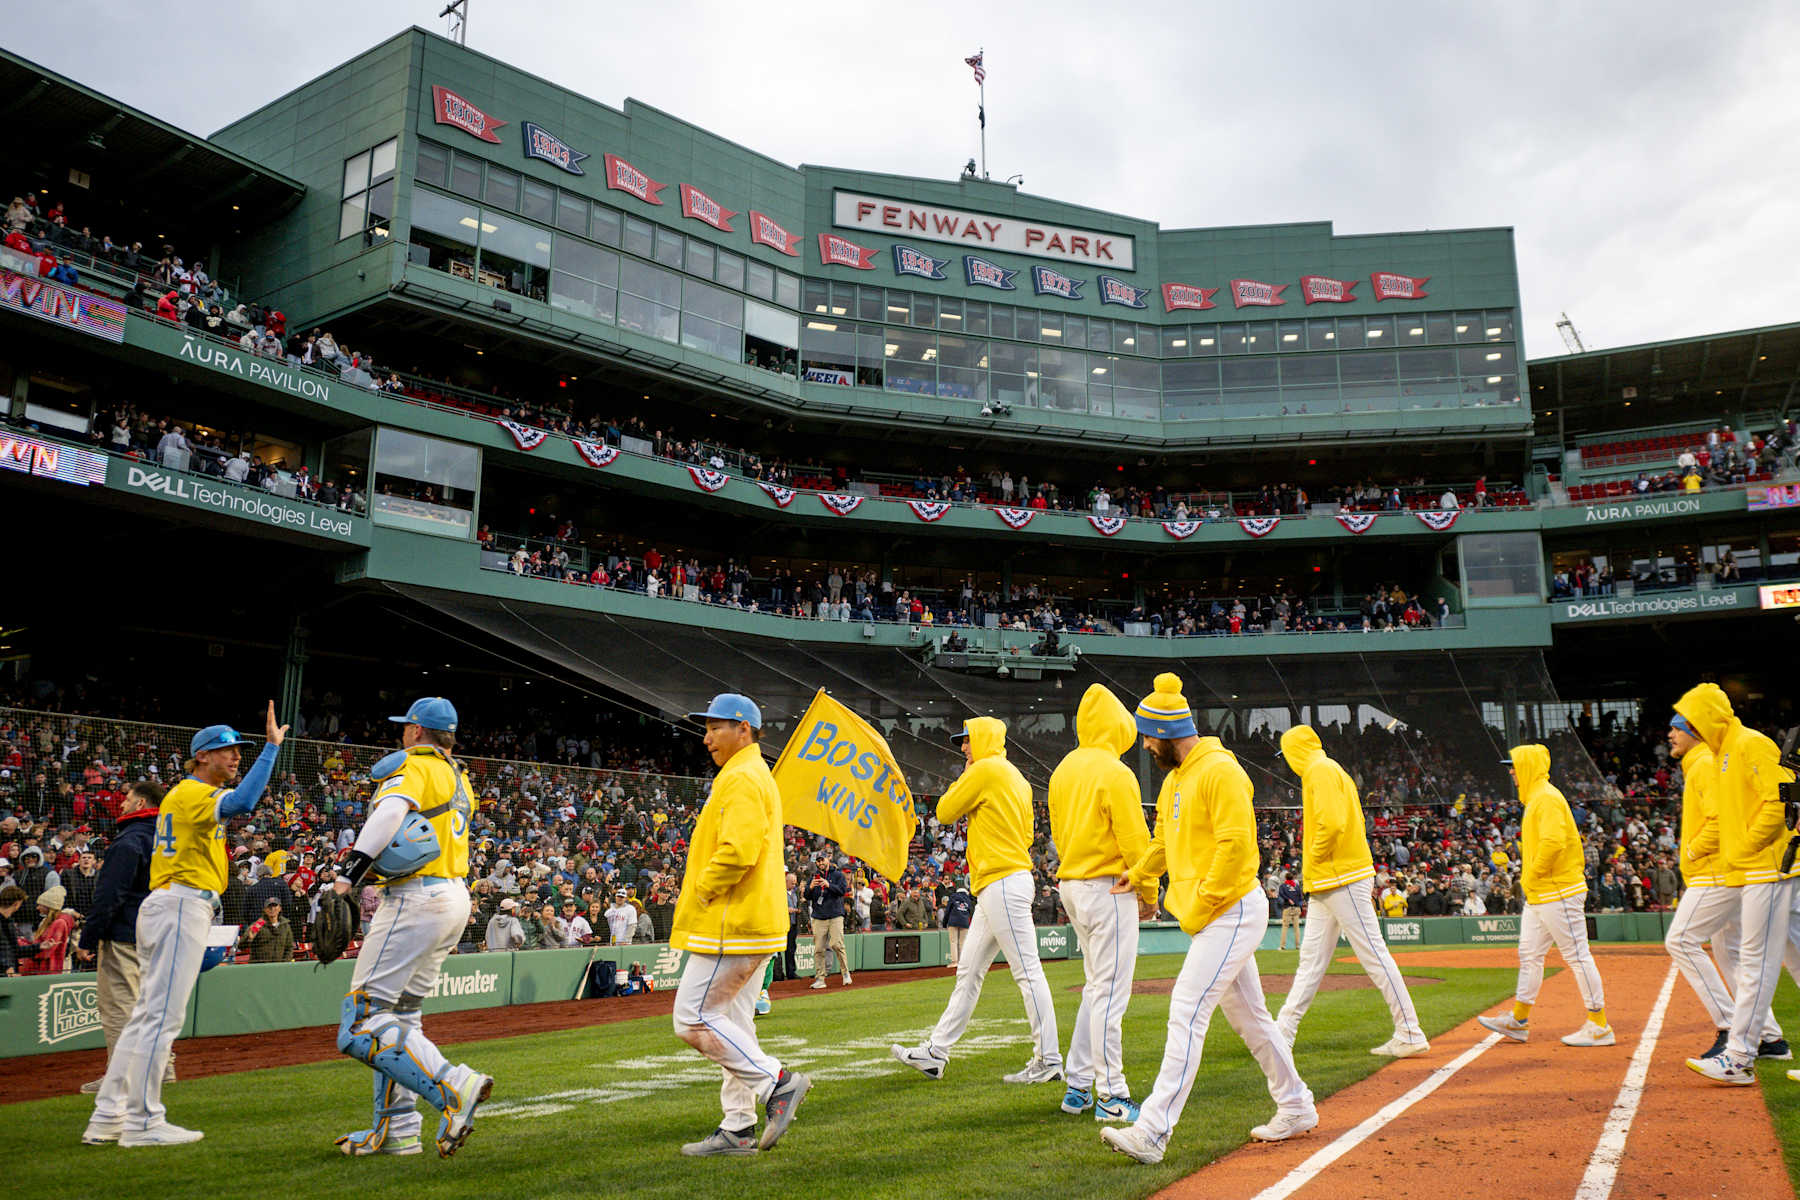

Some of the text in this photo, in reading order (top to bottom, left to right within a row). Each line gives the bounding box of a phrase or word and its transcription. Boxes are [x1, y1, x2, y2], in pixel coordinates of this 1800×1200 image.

[857, 201, 1113, 260] FENWAY PARK
[1238, 286, 1272, 299] 2007
[250, 363, 329, 400] PAVILION
[128, 467, 353, 536] DELL Technologies Level
[1635, 500, 1700, 517] PAVILION
[1568, 592, 1737, 617] DELL Technologies Level
[816, 776, 878, 829] WINS
[1040, 936, 1067, 946] IRVING
[1387, 922, 1420, 936] DICK'S
